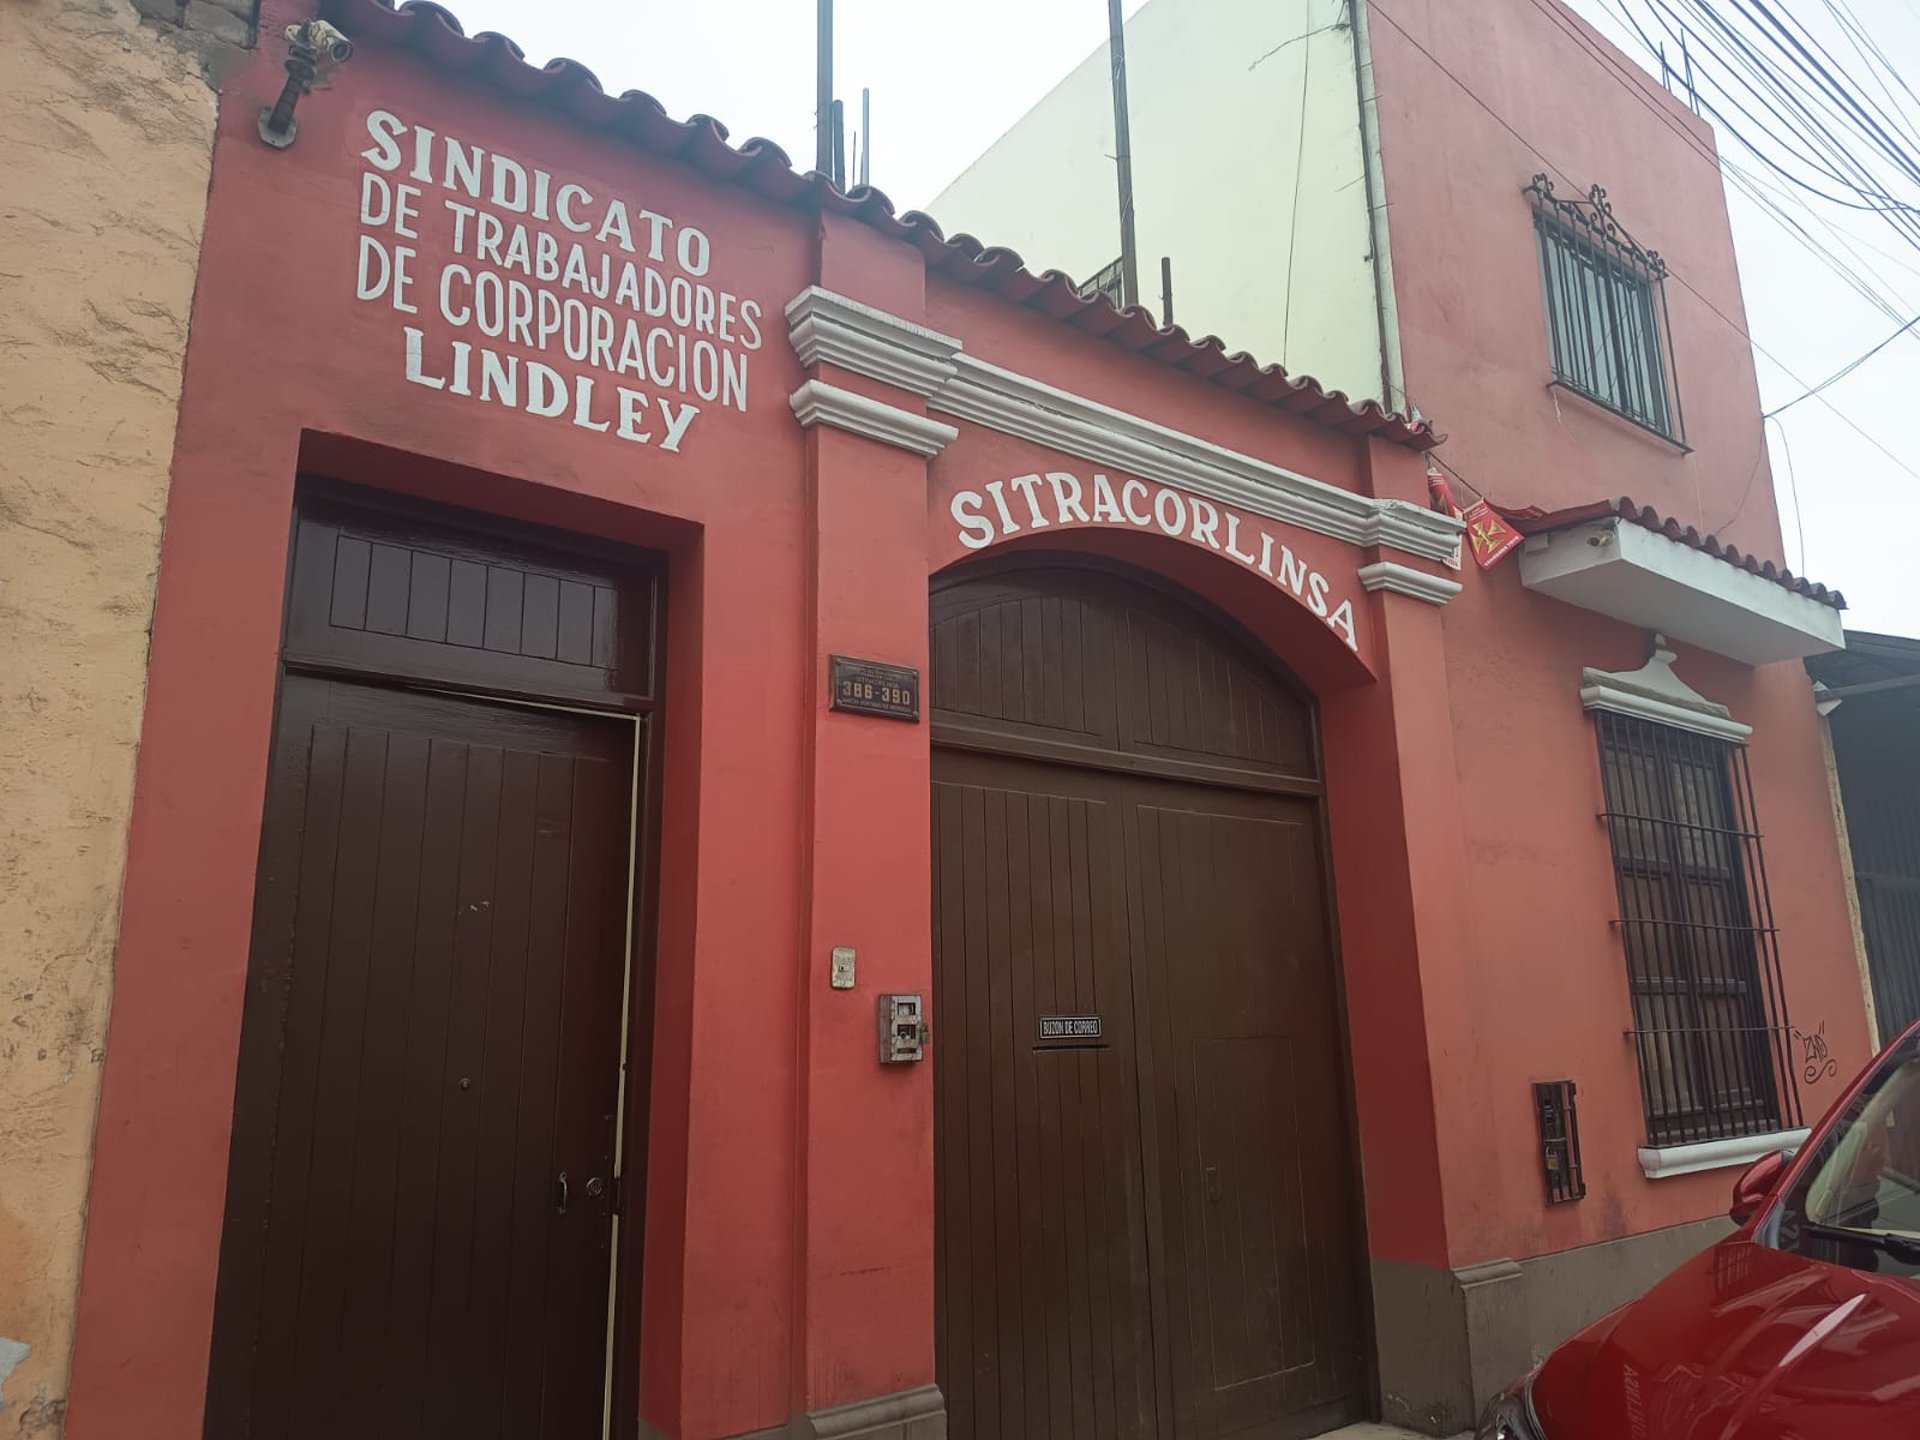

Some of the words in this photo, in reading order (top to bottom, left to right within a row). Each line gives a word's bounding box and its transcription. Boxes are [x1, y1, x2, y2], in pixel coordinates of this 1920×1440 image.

[360, 172, 422, 239] DE
[445, 199, 763, 350] TRABAJADORES
[361, 109, 710, 277] SINDICATO
[356, 234, 418, 314] DE
[439, 263, 748, 412] CORPORACION
[403, 326, 700, 453] LINDLEY
[950, 471, 1359, 653] SITRACORLINSA
